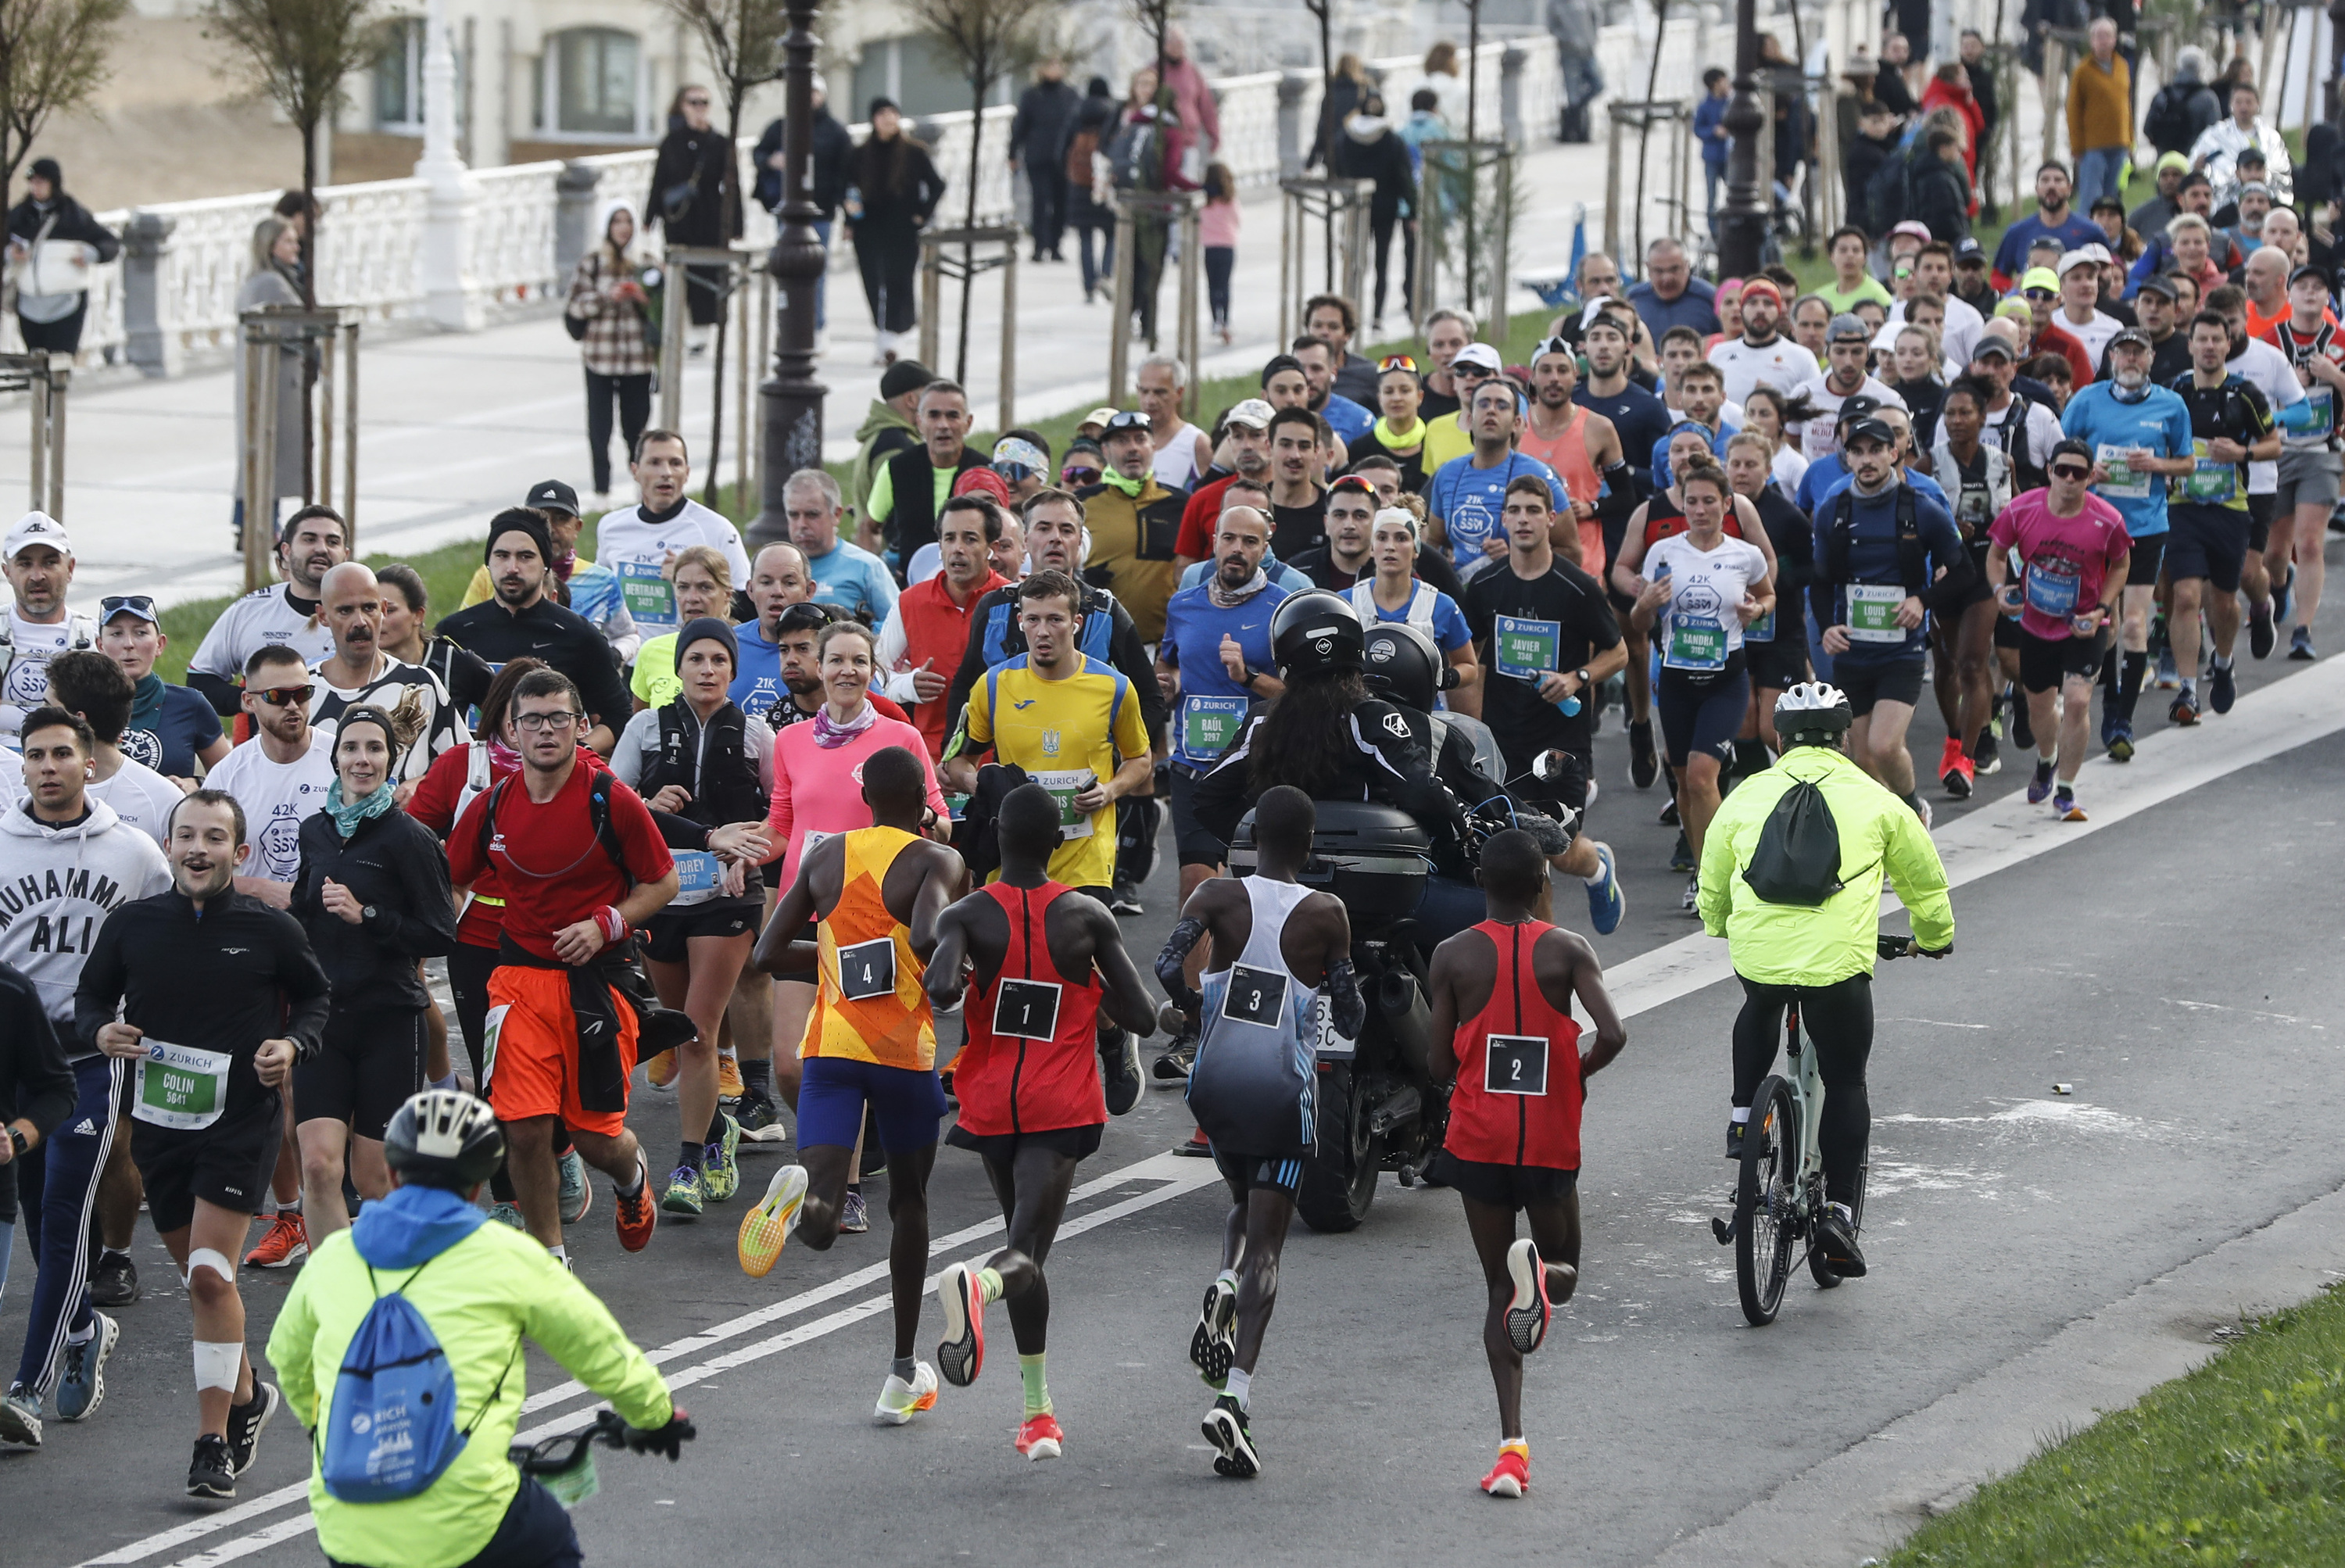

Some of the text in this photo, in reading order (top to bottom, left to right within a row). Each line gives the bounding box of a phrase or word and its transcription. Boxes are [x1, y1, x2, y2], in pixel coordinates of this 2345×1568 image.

[1466, 494, 1484, 505] 21K
[1689, 575, 1711, 584] 42K
[625, 582, 666, 599] BERTRAND
[1867, 590, 1896, 599] ZURICH
[1863, 604, 1887, 618] LOUIS
[1517, 623, 1549, 633] ZURICH
[1511, 639, 1540, 653] JAVIER
[1682, 632, 1714, 647] SANDRA
[754, 677, 777, 689] 21K
[1203, 701, 1236, 710] ZURICH
[1201, 717, 1223, 732] RAÚL
[1043, 776, 1079, 786] ZURICH
[272, 803, 299, 816] 42K
[29, 916, 93, 954] ALI
[862, 963, 872, 984] 4
[1249, 990, 1261, 1012] 3
[1022, 1004, 1031, 1025] 1
[170, 1052, 212, 1069] ZURICH
[1511, 1059, 1522, 1081] 2
[163, 1072, 195, 1094] COLIN
[166, 1091, 187, 1106] 5641
[73, 1128, 98, 1137] adidas
[224, 1186, 243, 1197] KIPSTA
